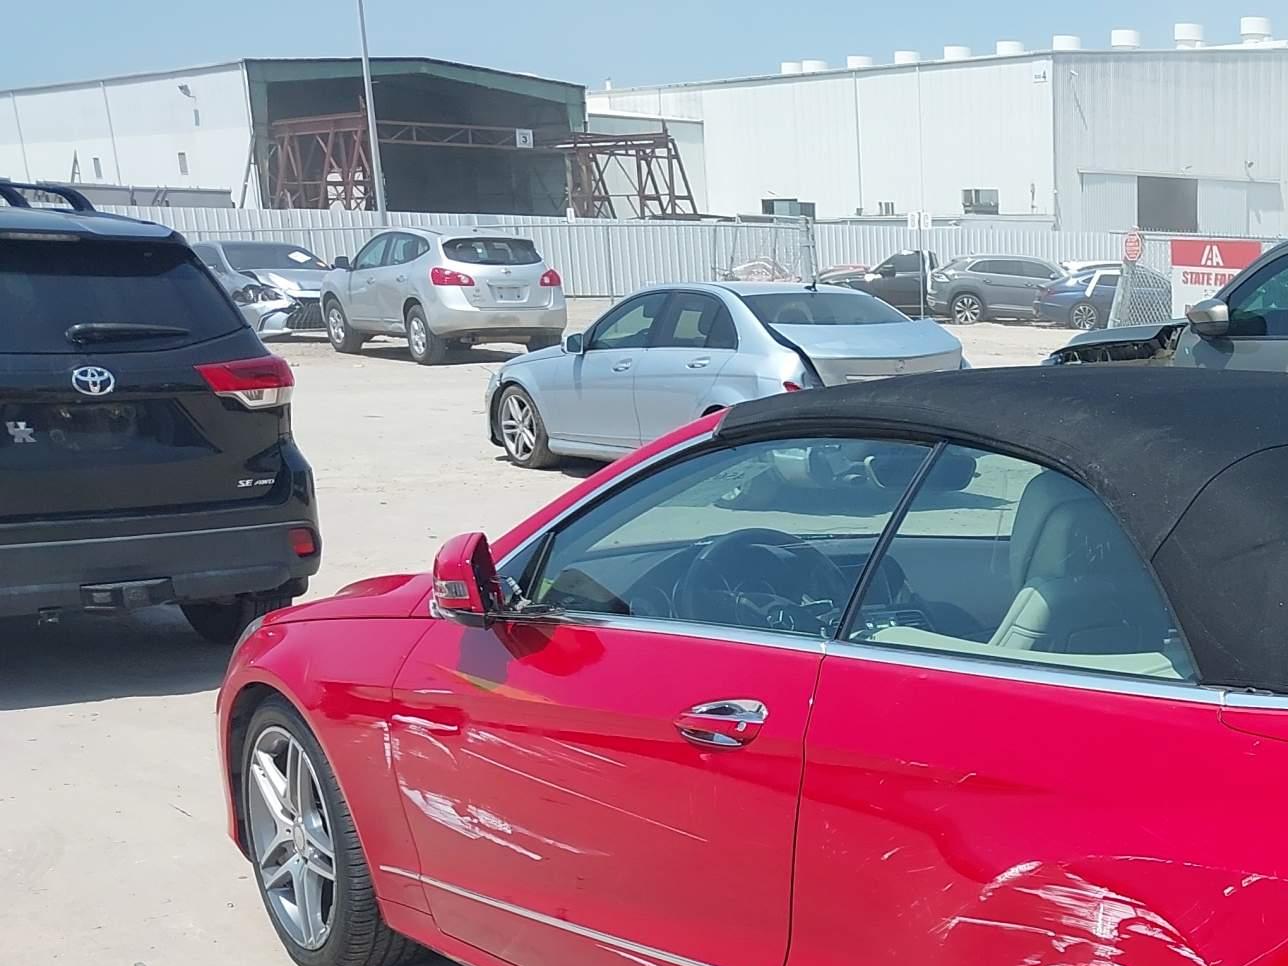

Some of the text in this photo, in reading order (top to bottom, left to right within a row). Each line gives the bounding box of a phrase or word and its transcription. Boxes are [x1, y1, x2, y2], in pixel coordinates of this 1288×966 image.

[1182, 270, 1235, 286] STATE FAR
[237, 477, 276, 488] SE AWD
